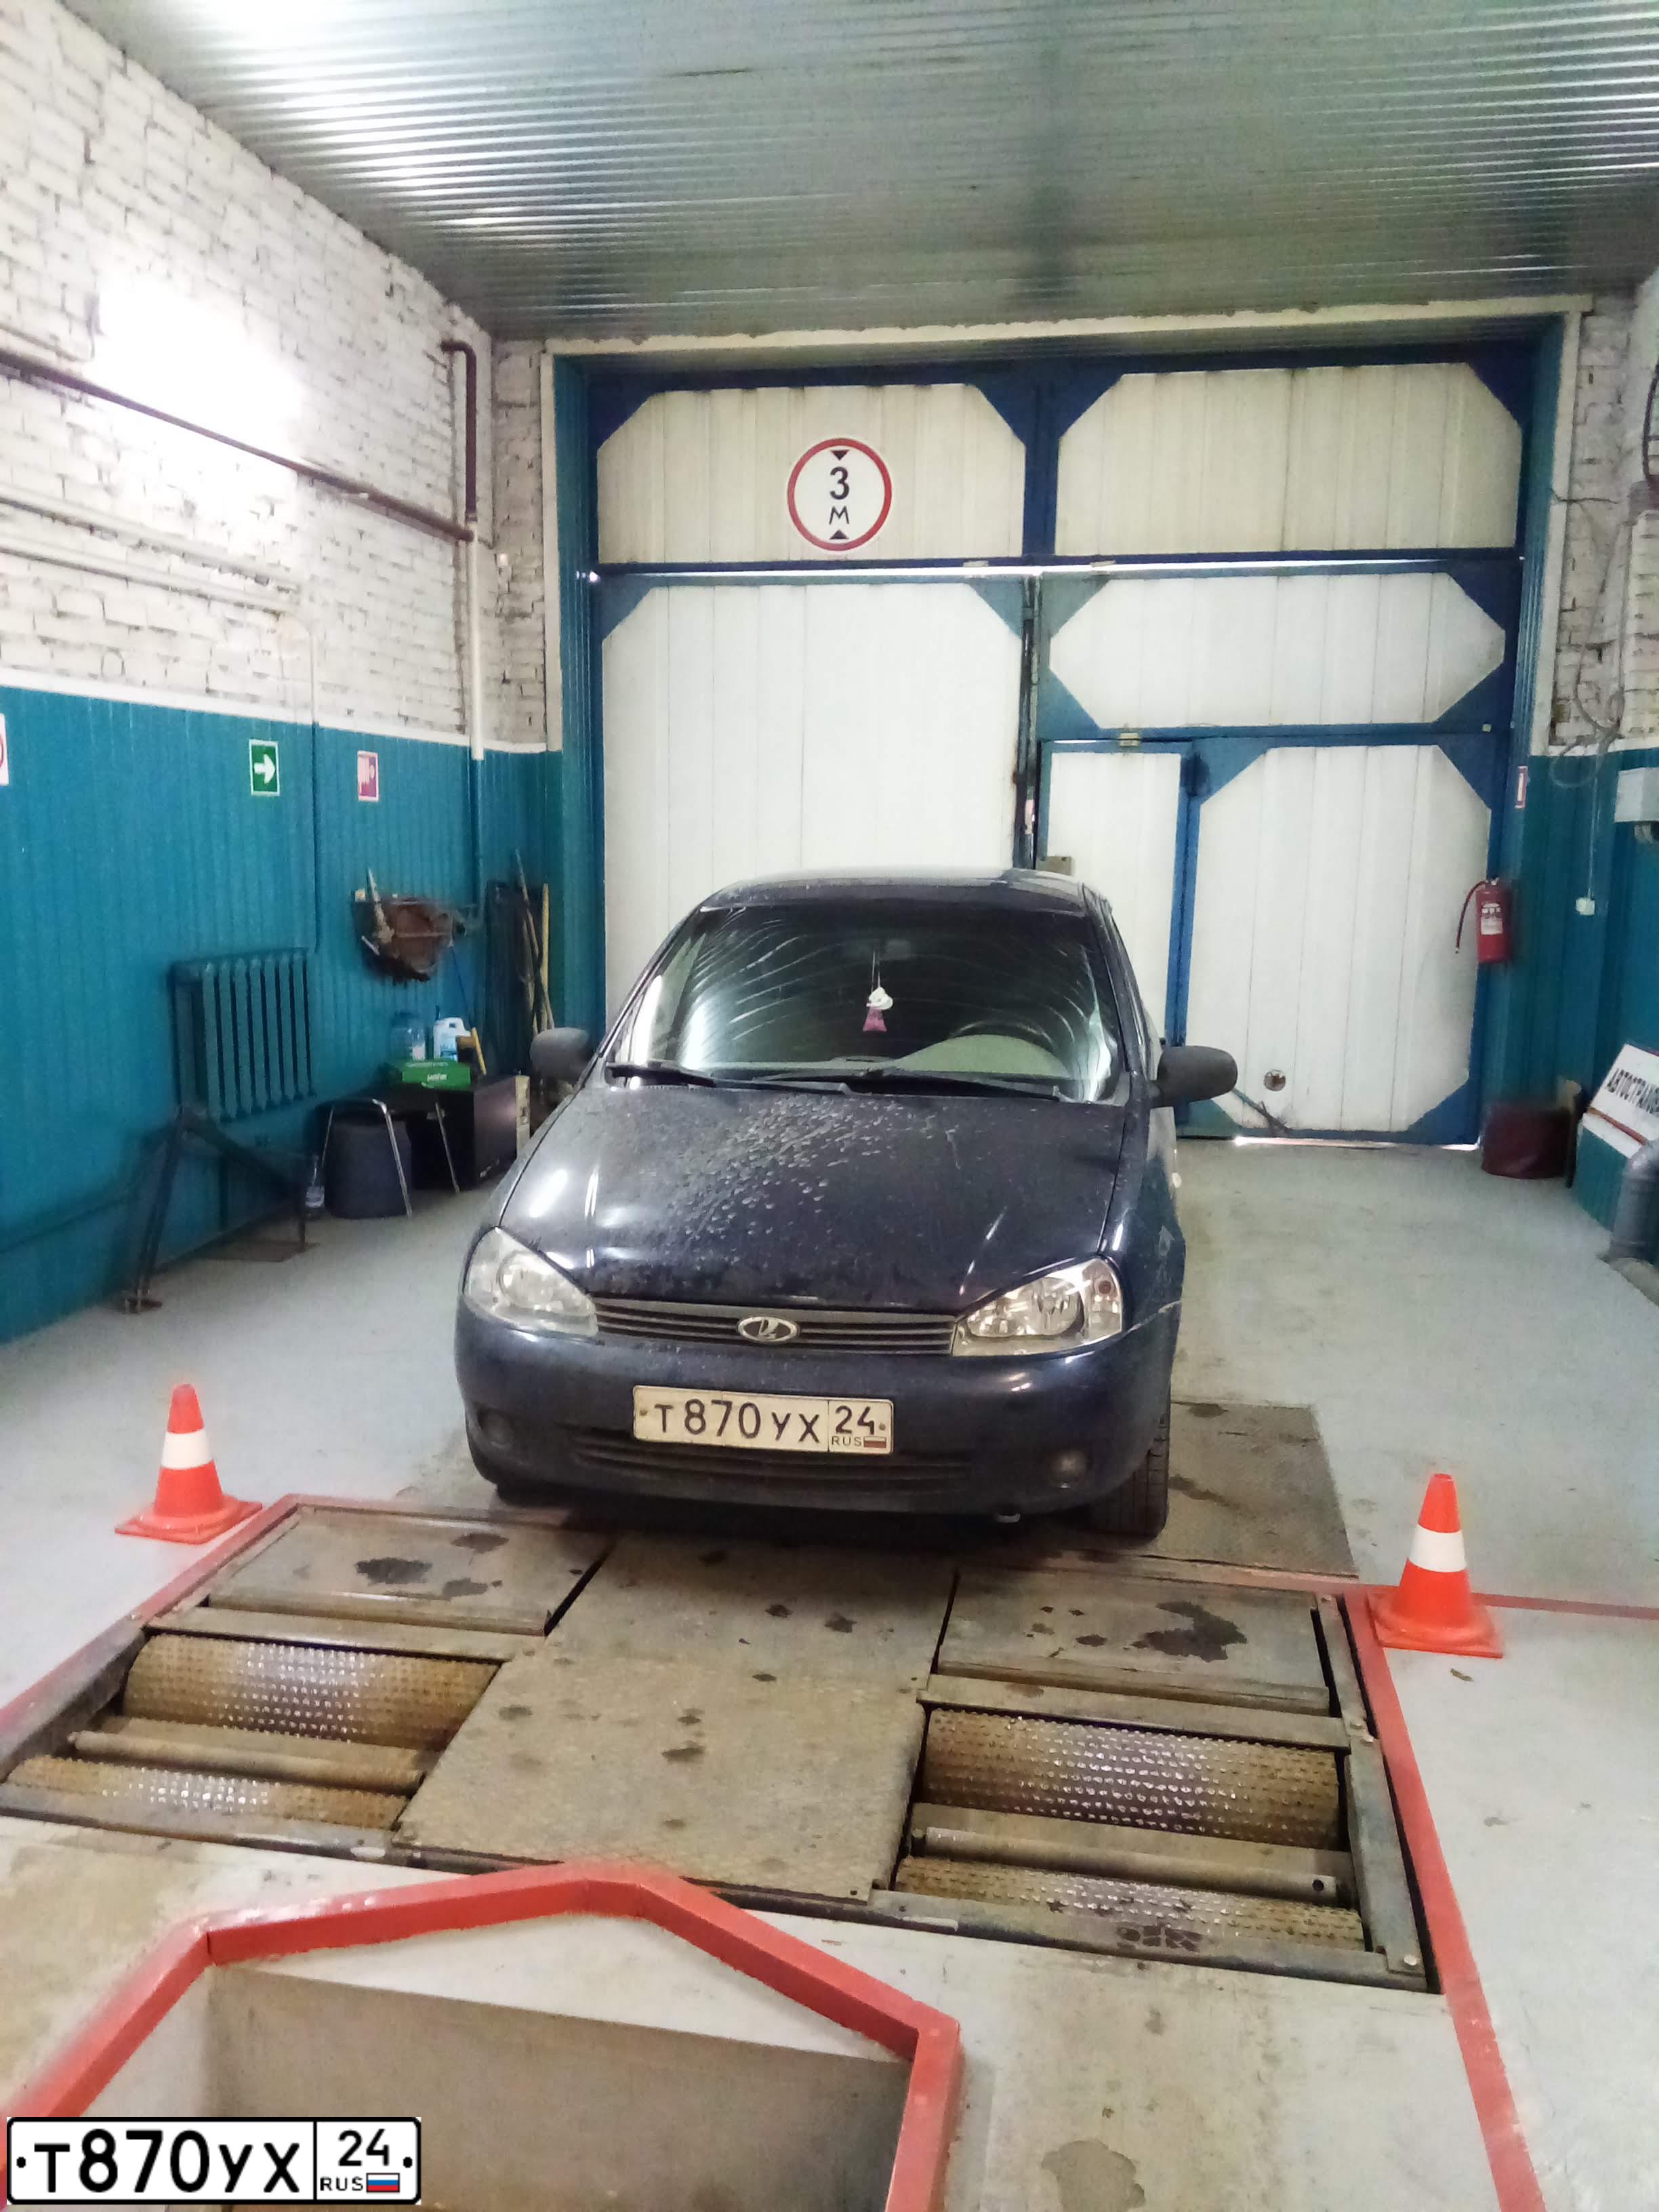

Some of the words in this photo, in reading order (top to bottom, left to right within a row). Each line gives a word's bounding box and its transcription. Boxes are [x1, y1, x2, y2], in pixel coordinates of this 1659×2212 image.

[829, 466, 850, 500] 3
[835, 1405, 875, 1435] 24
[832, 1436, 862, 1448] RUS
